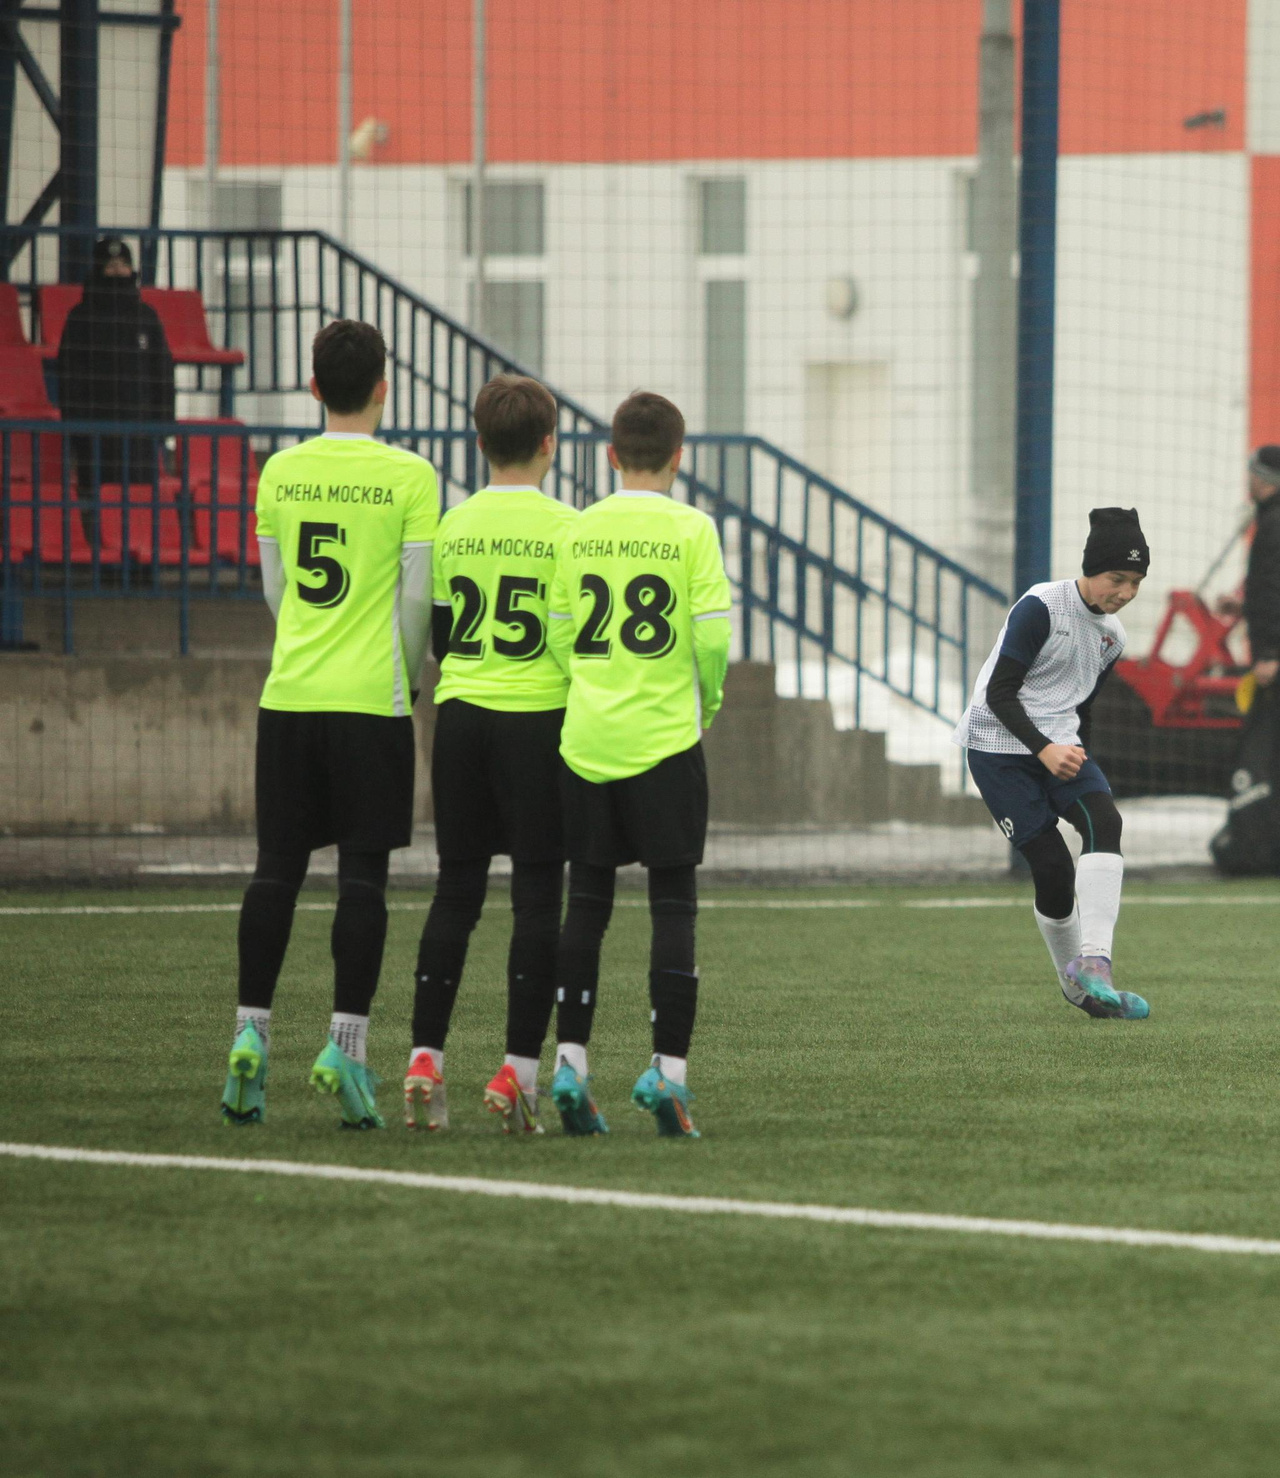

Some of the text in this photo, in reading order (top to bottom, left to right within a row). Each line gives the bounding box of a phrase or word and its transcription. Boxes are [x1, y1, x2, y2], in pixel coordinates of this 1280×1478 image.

[276, 484, 394, 506] СМЕНА МОСКВА
[441, 538, 554, 560] СМЕНА МОСКВА
[572, 540, 680, 561] СМЕНА МОСКВА
[296, 521, 351, 609] 5
[448, 575, 547, 661] 25
[573, 573, 677, 660] 28
[1000, 817, 1014, 838] 19
